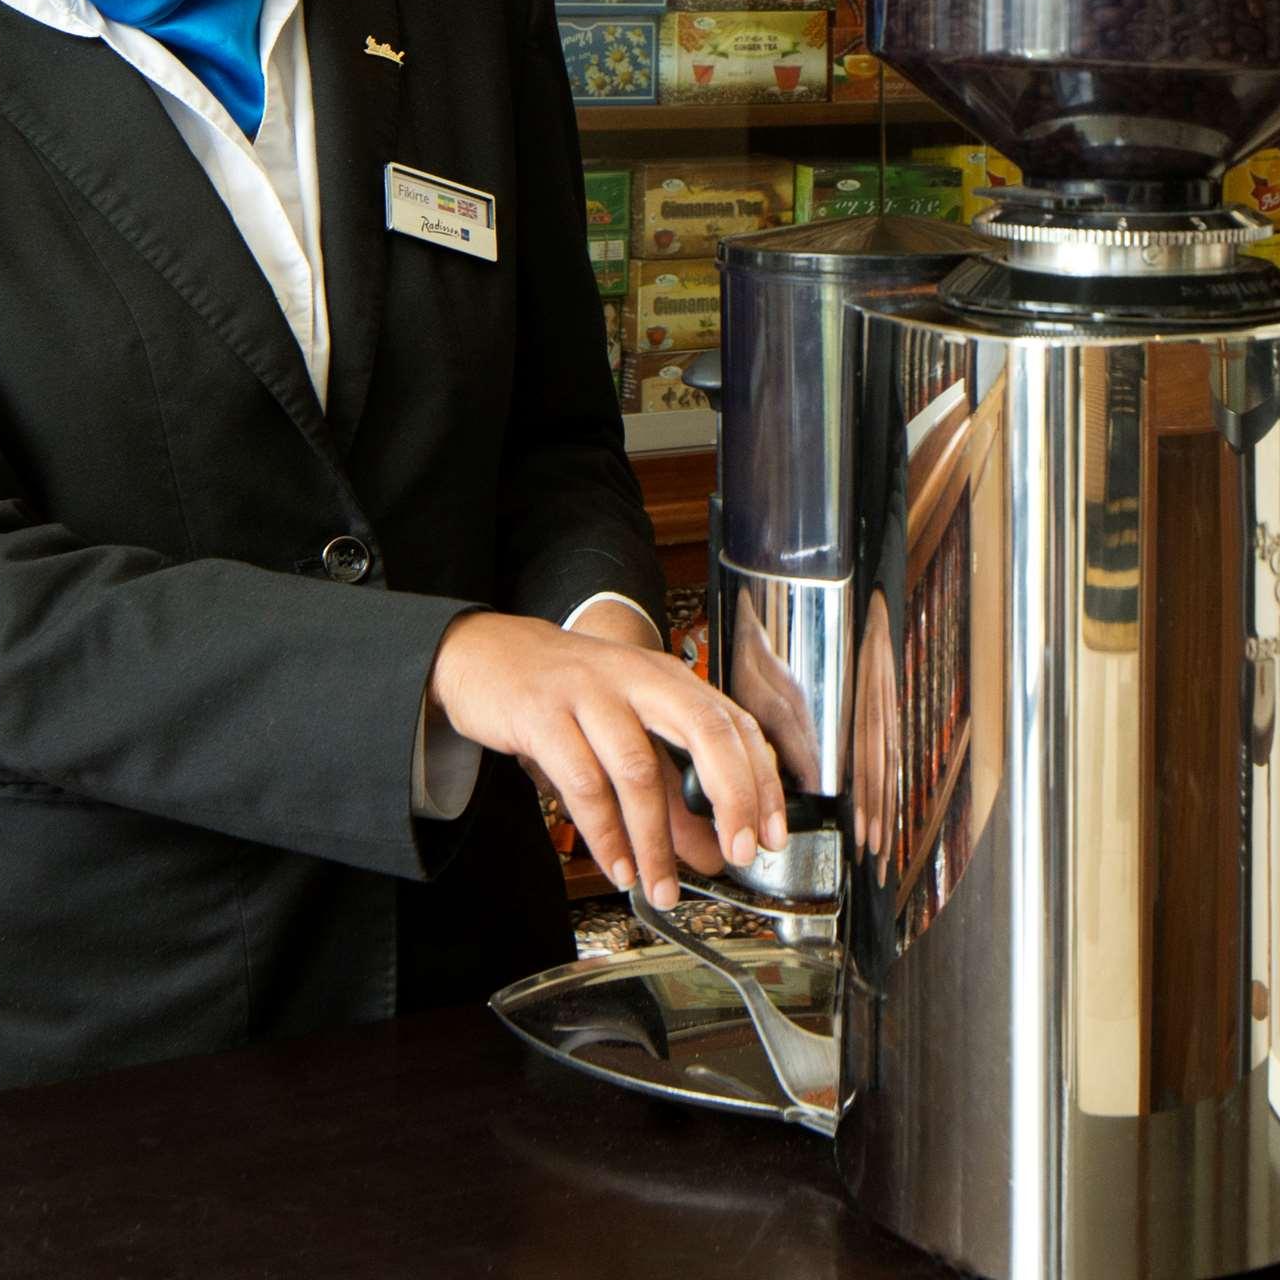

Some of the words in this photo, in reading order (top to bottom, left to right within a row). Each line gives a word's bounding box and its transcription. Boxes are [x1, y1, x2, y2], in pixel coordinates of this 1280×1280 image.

[398, 183, 430, 205] Fikirte
[660, 200, 734, 220] Cinnamon
[420, 215, 461, 238] Radisson
[653, 296, 721, 316] Cinnamo
